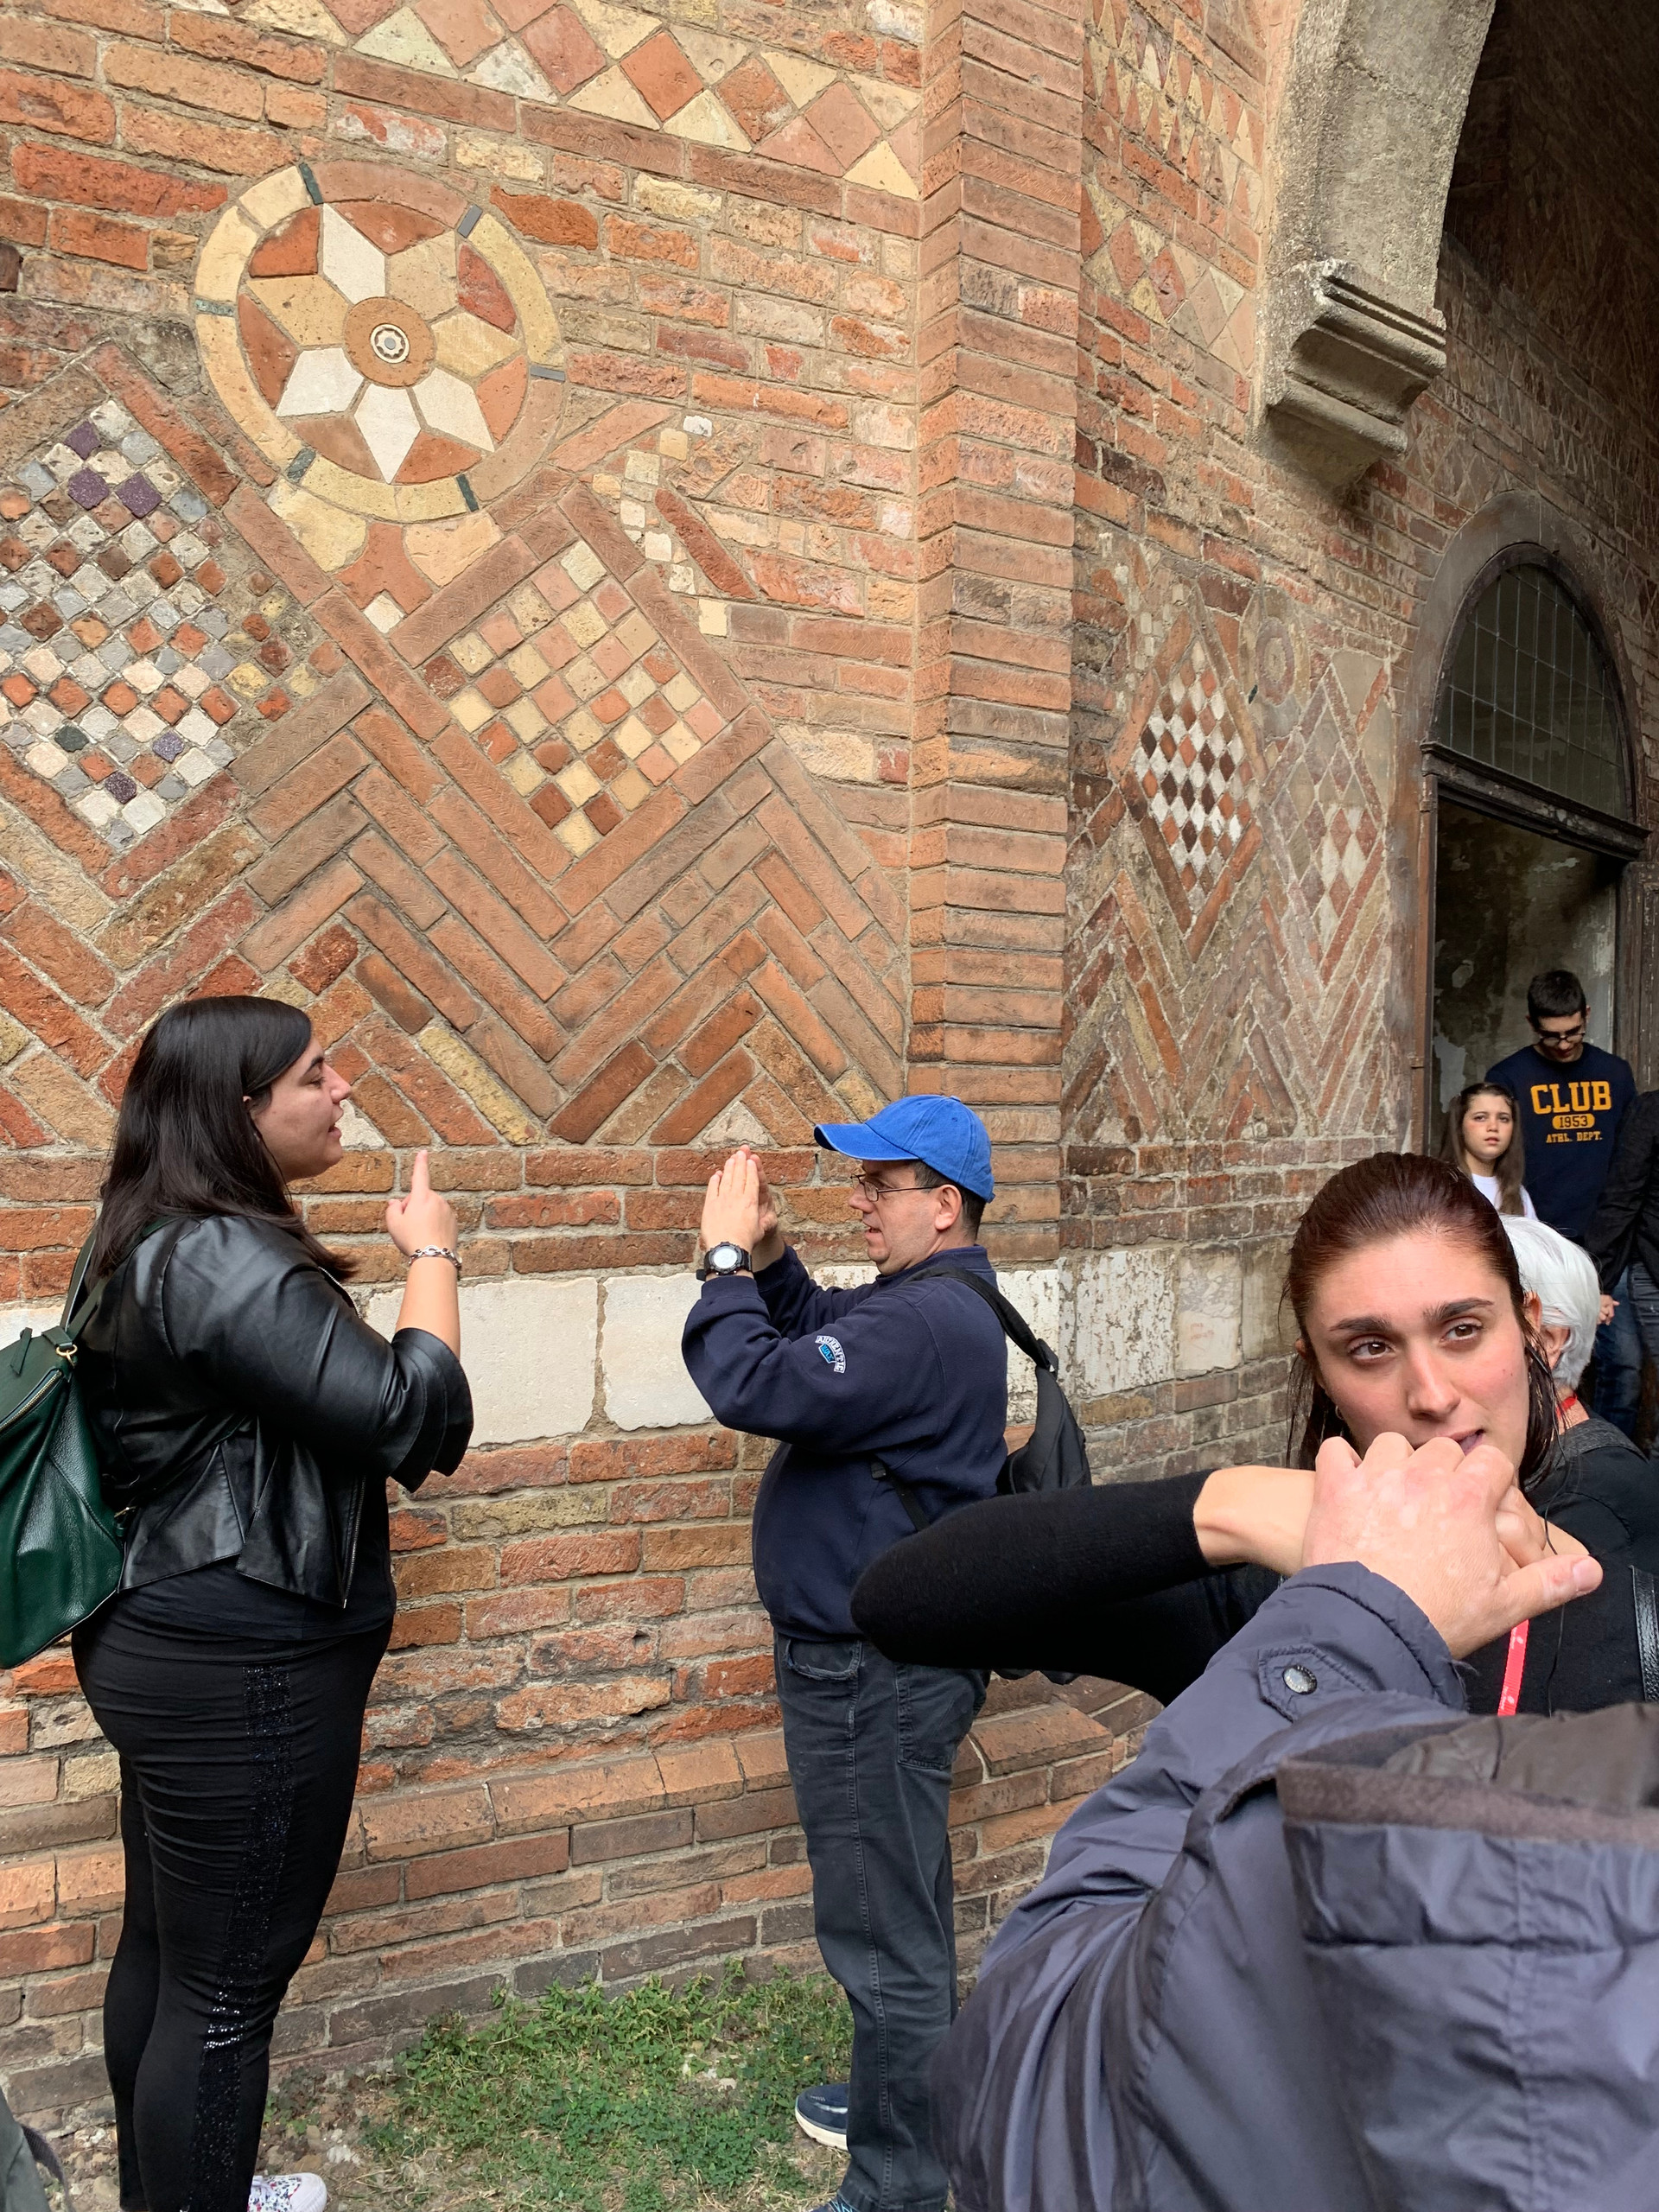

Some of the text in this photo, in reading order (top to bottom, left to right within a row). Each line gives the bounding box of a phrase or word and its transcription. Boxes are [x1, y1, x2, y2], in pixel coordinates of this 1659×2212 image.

[1530, 1081, 1612, 1114] CLUB
[1559, 1115, 1588, 1128] 1953
[1546, 1131, 1603, 1143] ATHL. DEPT.
[817, 1336, 845, 1372] AUTHENTIC
